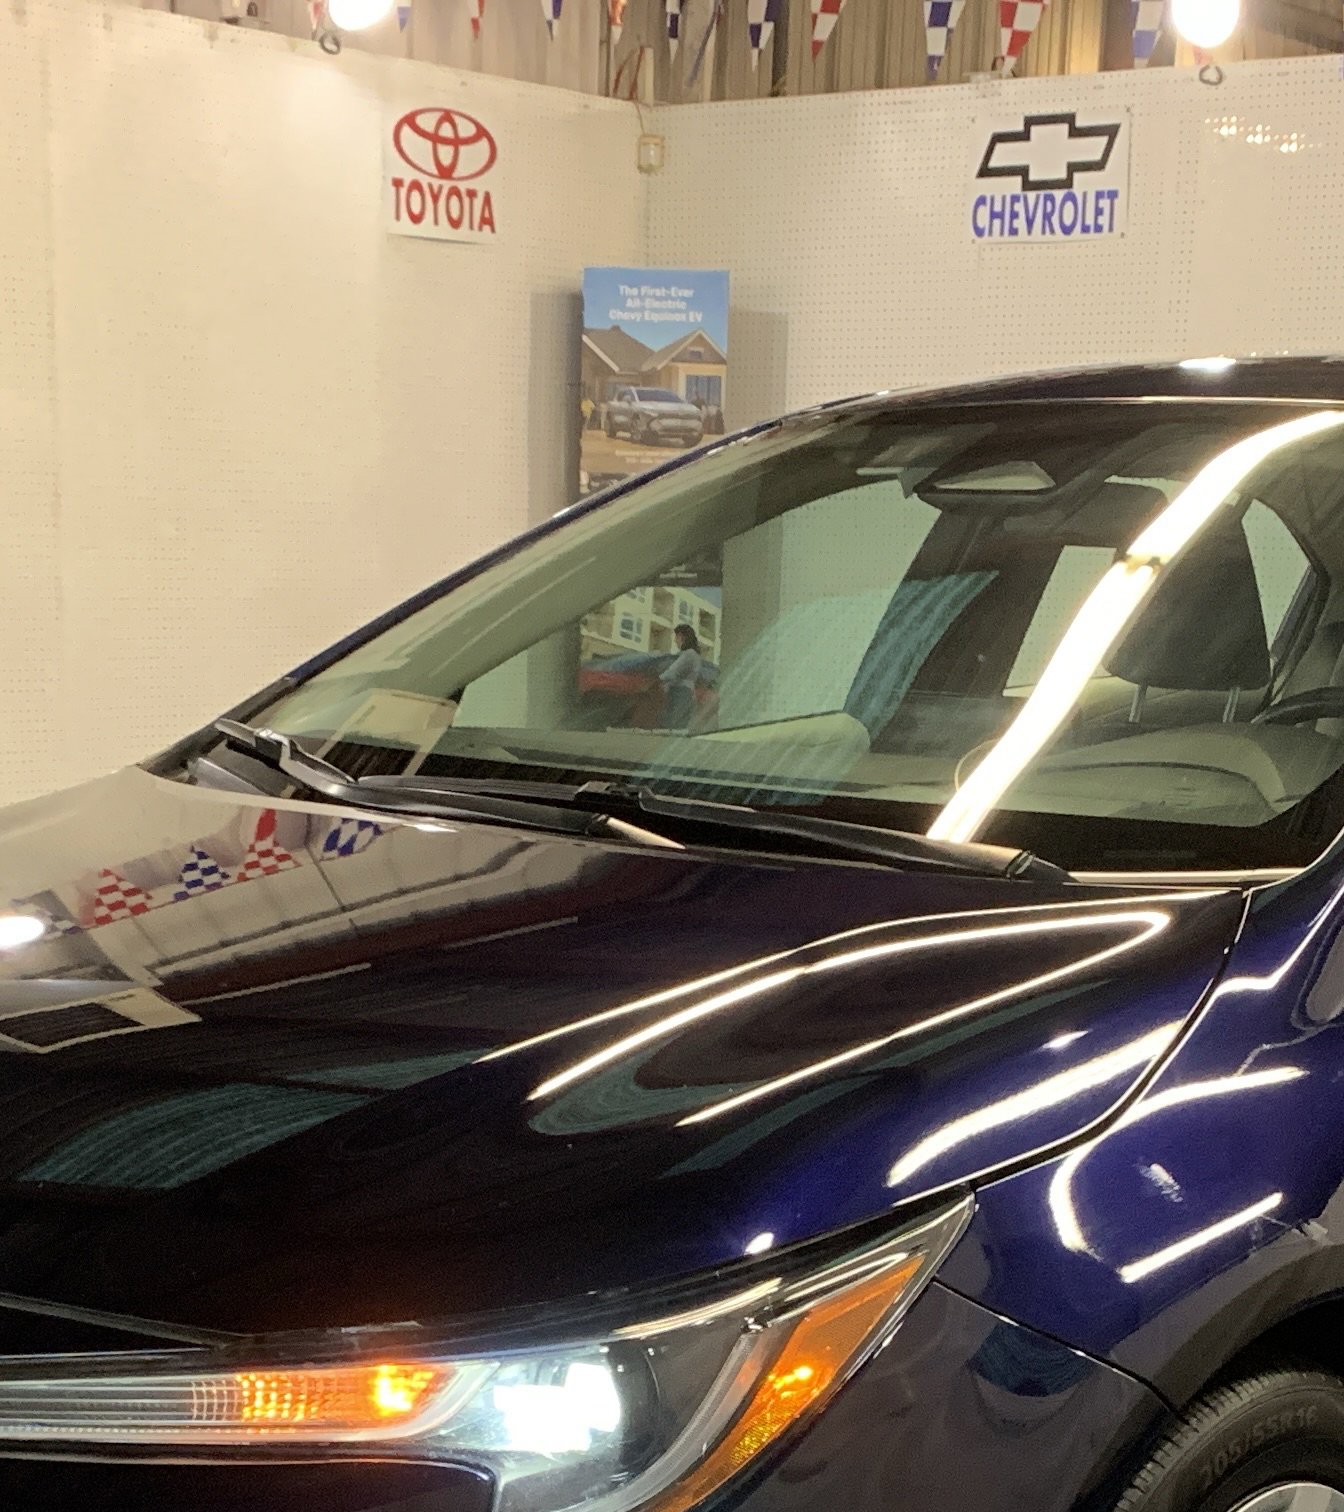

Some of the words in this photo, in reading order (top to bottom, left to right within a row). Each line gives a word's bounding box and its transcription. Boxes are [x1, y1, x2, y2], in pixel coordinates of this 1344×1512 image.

[391, 177, 496, 234] TOYOTA
[972, 189, 1119, 238] CHEVROLET
[618, 284, 639, 297] The
[609, 309, 642, 322] Chevy
[688, 311, 703, 322] EV
